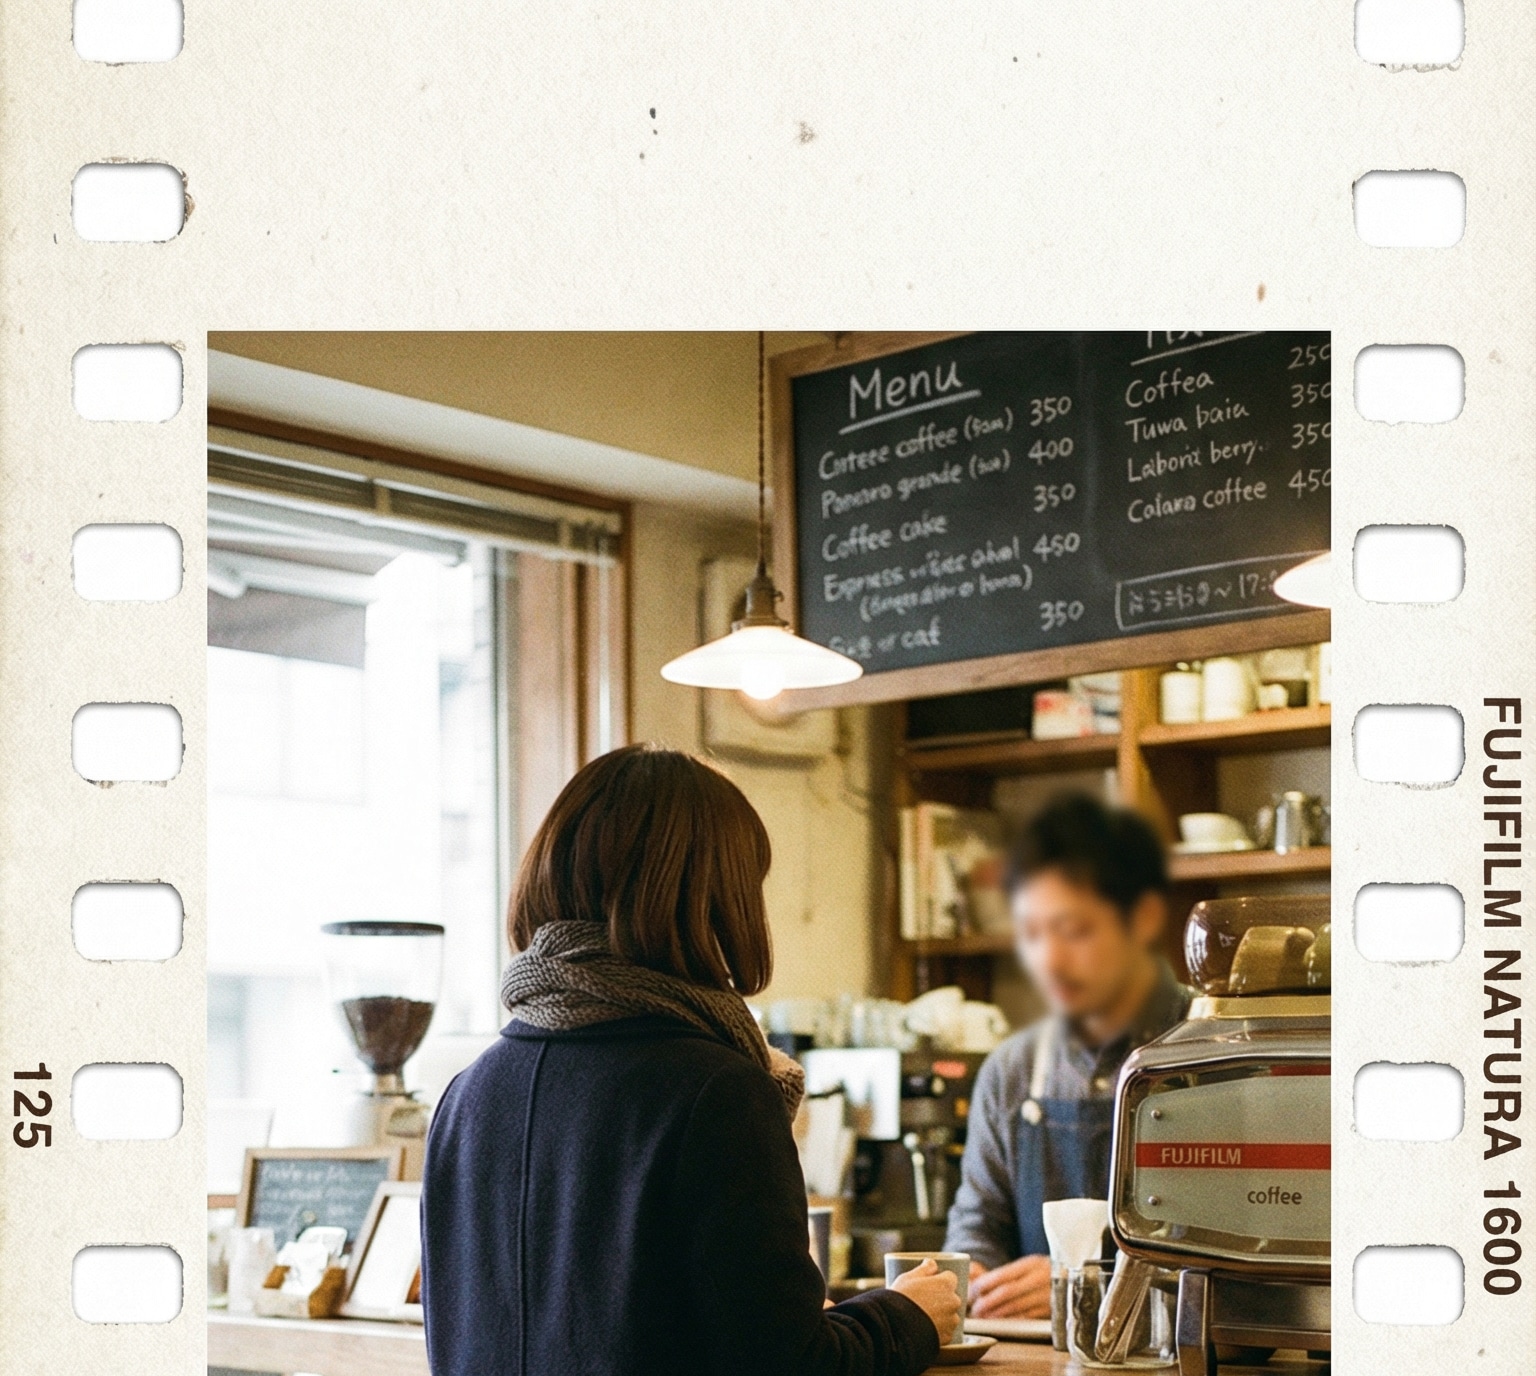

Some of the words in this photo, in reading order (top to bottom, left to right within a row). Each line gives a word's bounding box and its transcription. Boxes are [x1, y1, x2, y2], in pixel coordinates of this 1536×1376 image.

[850, 361, 963, 419] Menu
[1125, 367, 1214, 408] Coffea
[1030, 396, 1073, 427] 350
[1028, 437, 1074, 466] 400
[1202, 476, 1268, 508] coffee
[822, 523, 893, 562] Coffee
[1033, 482, 1076, 513] 350
[1032, 532, 1081, 562] 450
[1039, 600, 1085, 632] 350
[1161, 1147, 1242, 1165] FUJIFILM
[1247, 1186, 1303, 1205] coffee
